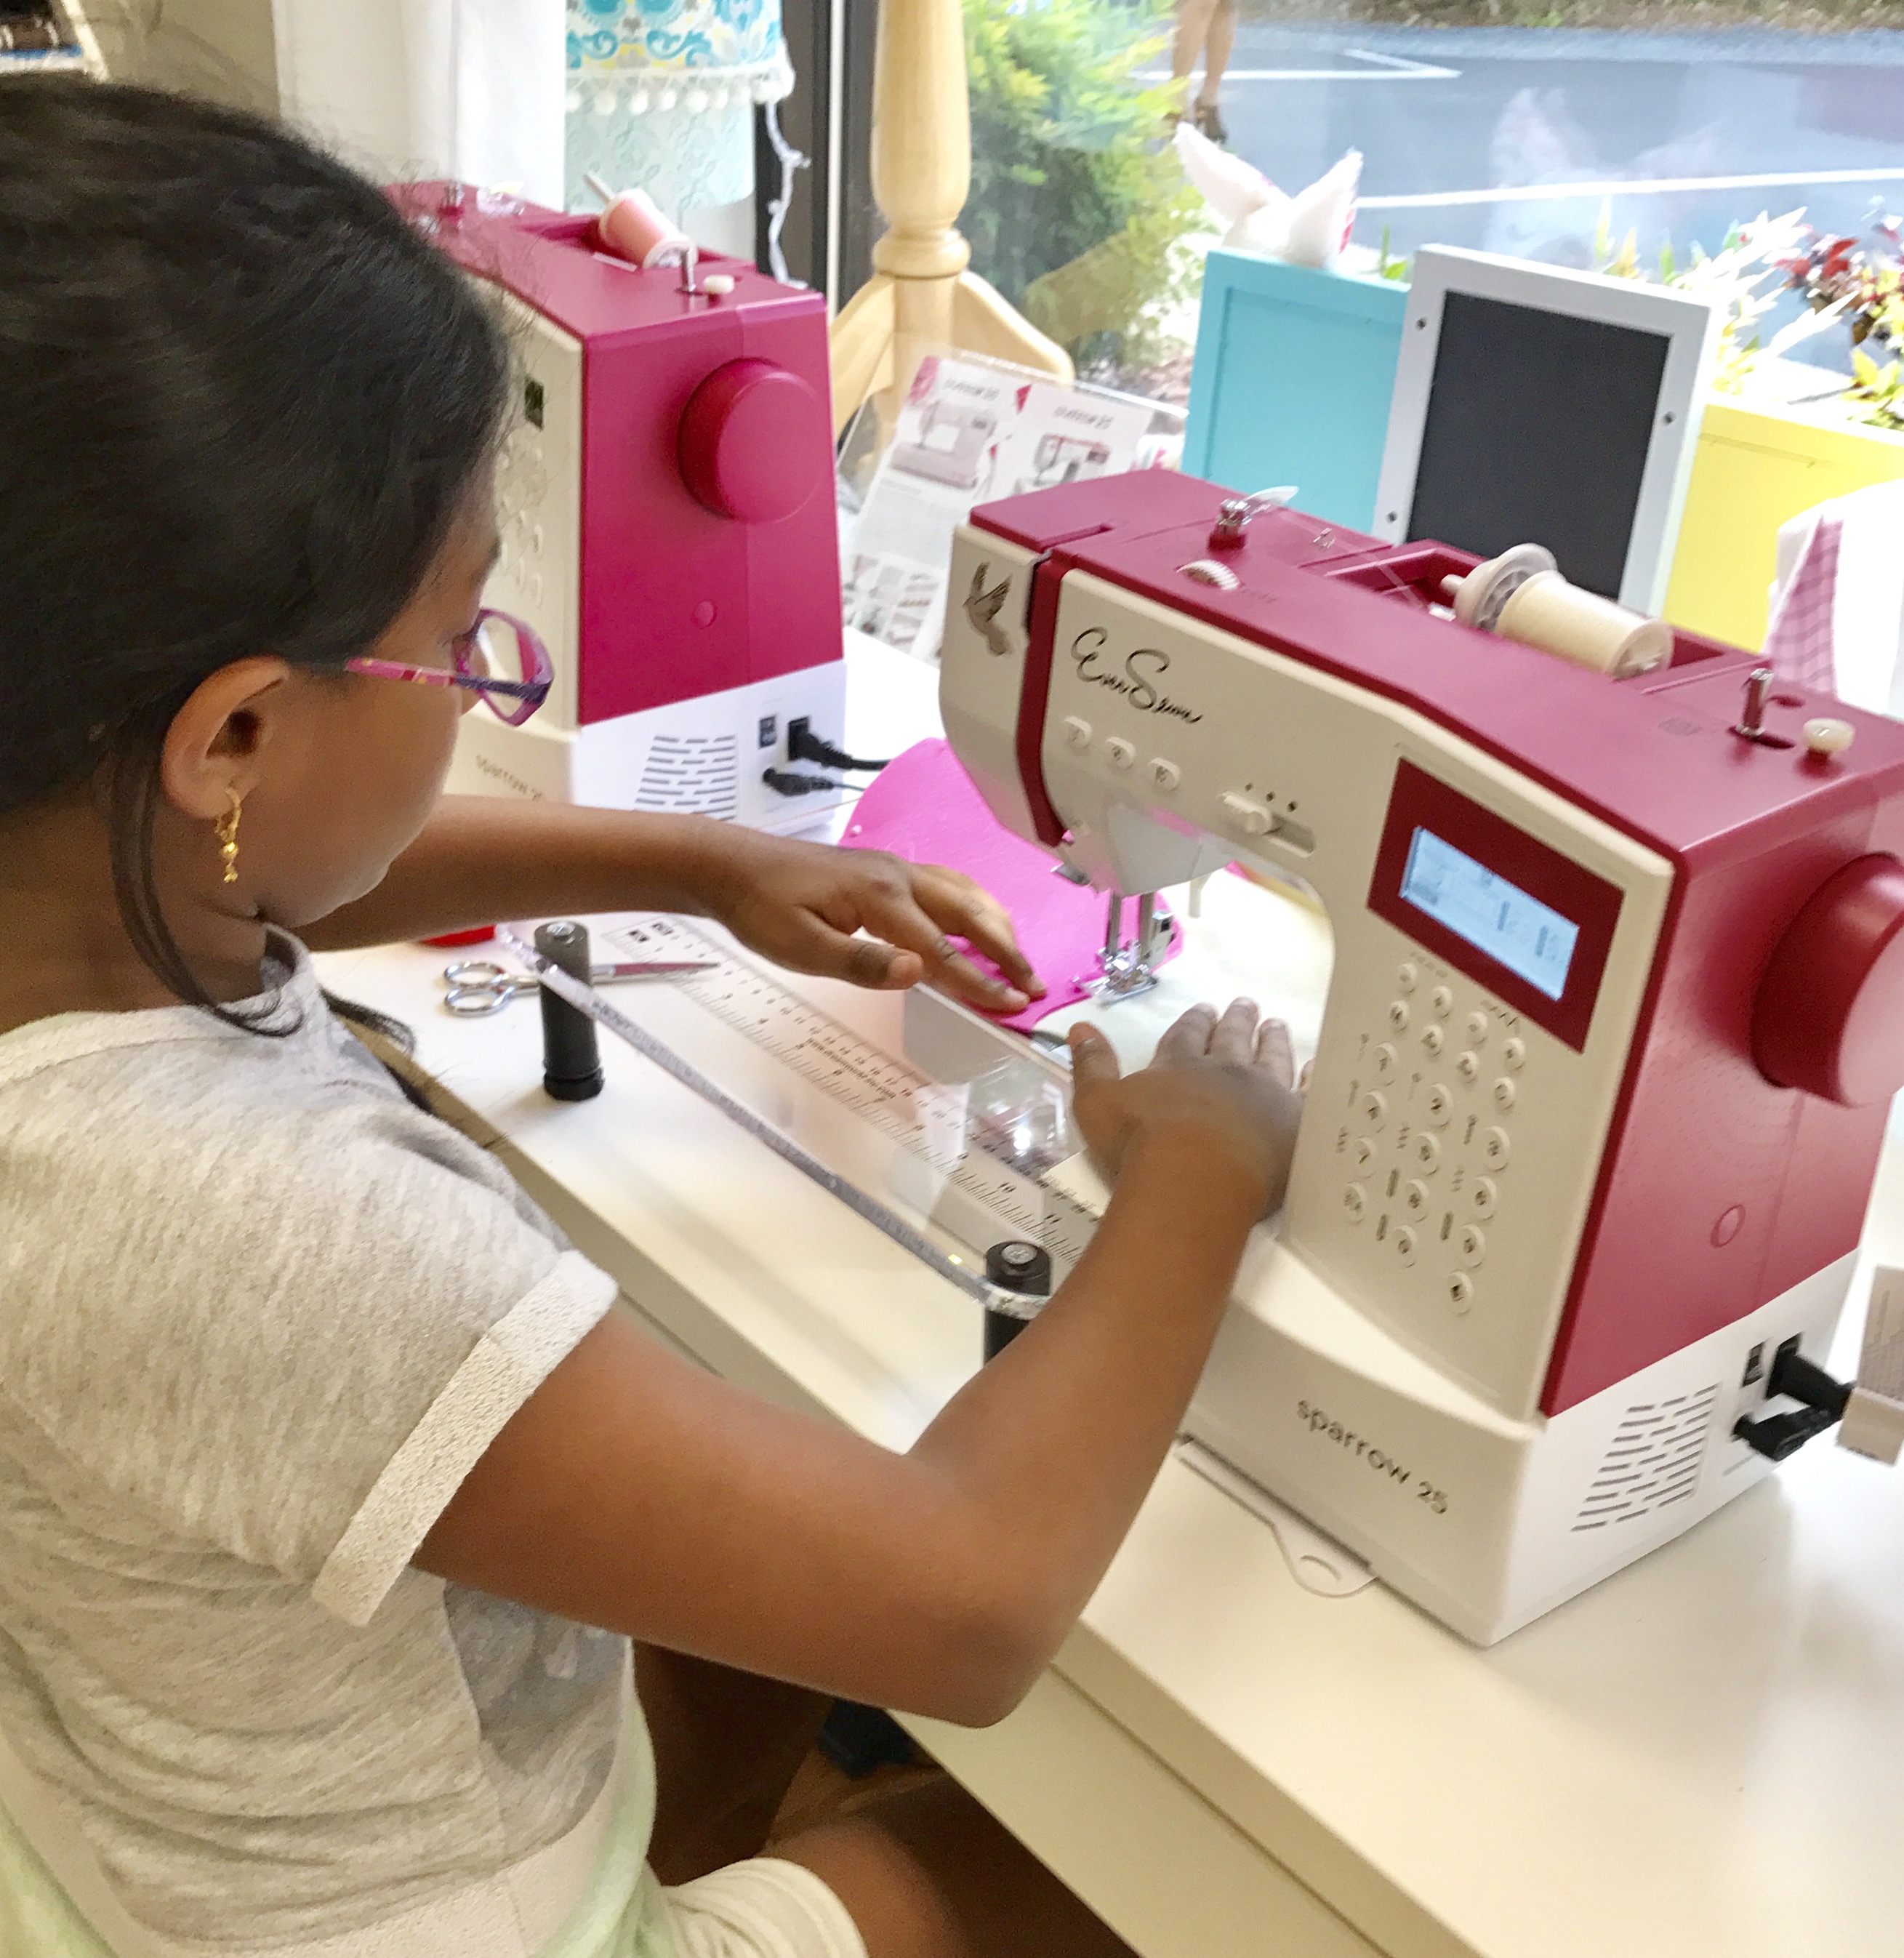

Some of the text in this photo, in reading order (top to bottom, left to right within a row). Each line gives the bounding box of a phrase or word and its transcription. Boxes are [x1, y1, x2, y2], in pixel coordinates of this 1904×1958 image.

[997, 1181, 1017, 1192] 10
[1044, 1213, 1062, 1224] 11
[1297, 1400, 1448, 1514] sparrow 25
